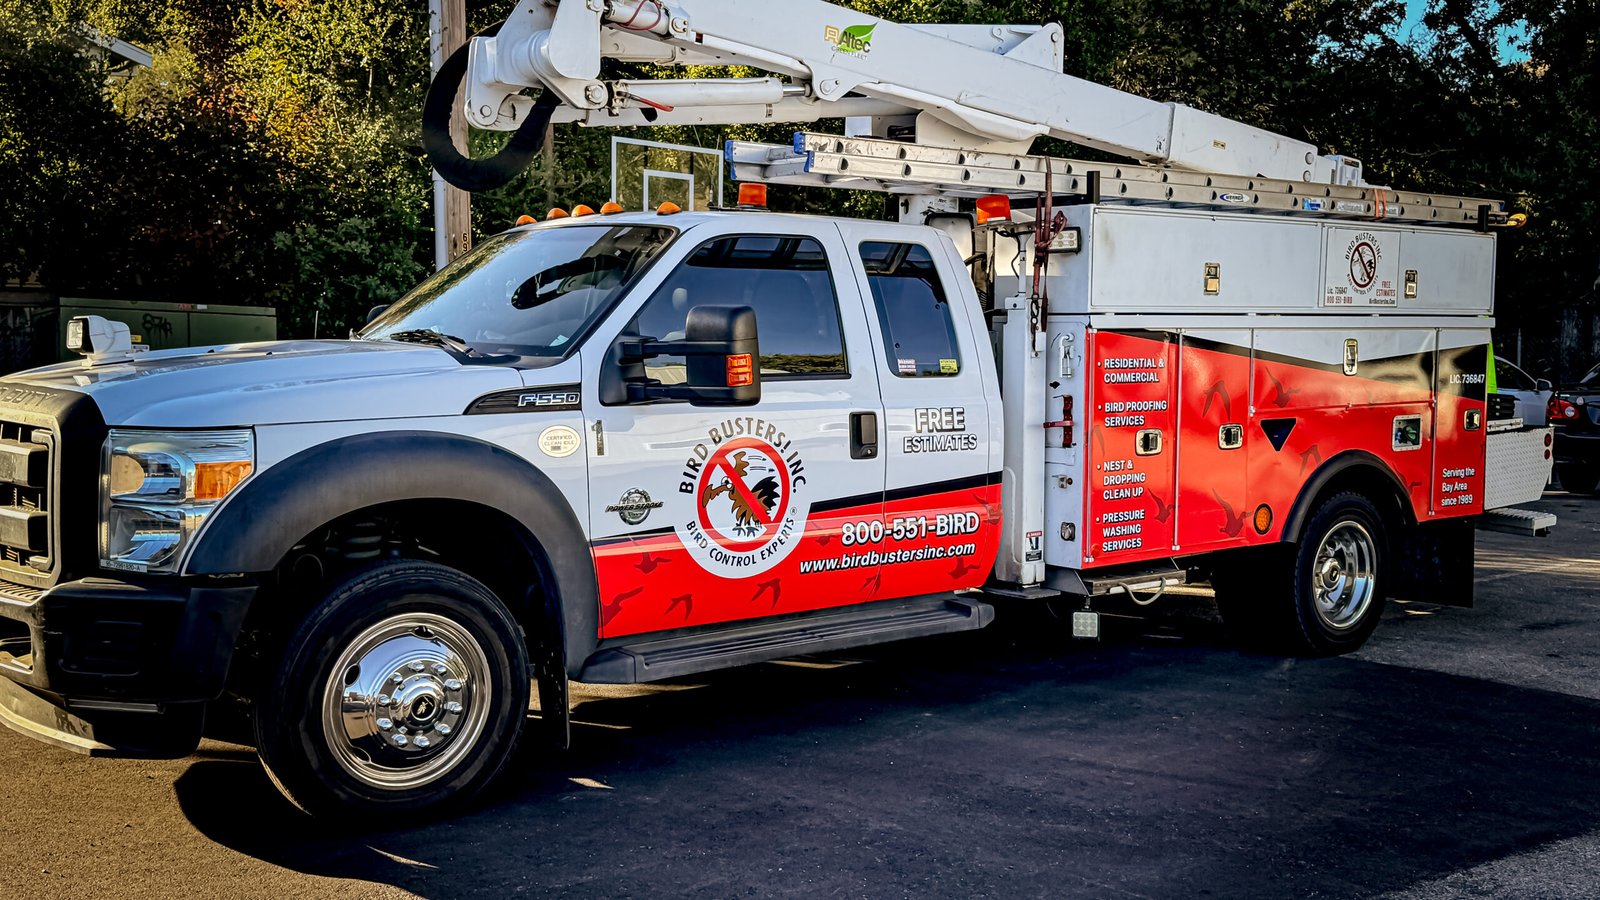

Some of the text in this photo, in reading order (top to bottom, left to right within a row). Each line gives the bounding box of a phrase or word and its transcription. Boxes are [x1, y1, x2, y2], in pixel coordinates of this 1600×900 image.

[839, 31, 871, 53] Altec
[1345, 240, 1356, 260] BIRD
[1104, 358, 1165, 369] RESIDENTIAL &
[1104, 372, 1160, 383] COMMERCIAL
[518, 392, 580, 407] F-550
[1105, 400, 1167, 413] BIRD PROOFING
[915, 407, 965, 432] FREE
[1104, 415, 1145, 427] SERVICES
[903, 434, 977, 453] ESTIMATES
[679, 417, 807, 494] BIRD BUSTERS! INC.
[1103, 459, 1134, 472] NEST &
[1442, 467, 1475, 478] Serving the
[1103, 472, 1146, 486] DROPPING
[1103, 487, 1144, 500] CLEAN UP
[1442, 481, 1468, 493] Bay Area
[1441, 494, 1473, 506] since 1989
[1102, 509, 1145, 523] PRESSURE
[841, 512, 980, 546] 800-551-BIRD
[1102, 523, 1142, 538] WASHING
[686, 518, 794, 567] BIRD CONTROL EXPERTS
[1102, 537, 1142, 552] SERVICES
[800, 542, 976, 574] www.birdbustersinc.com
